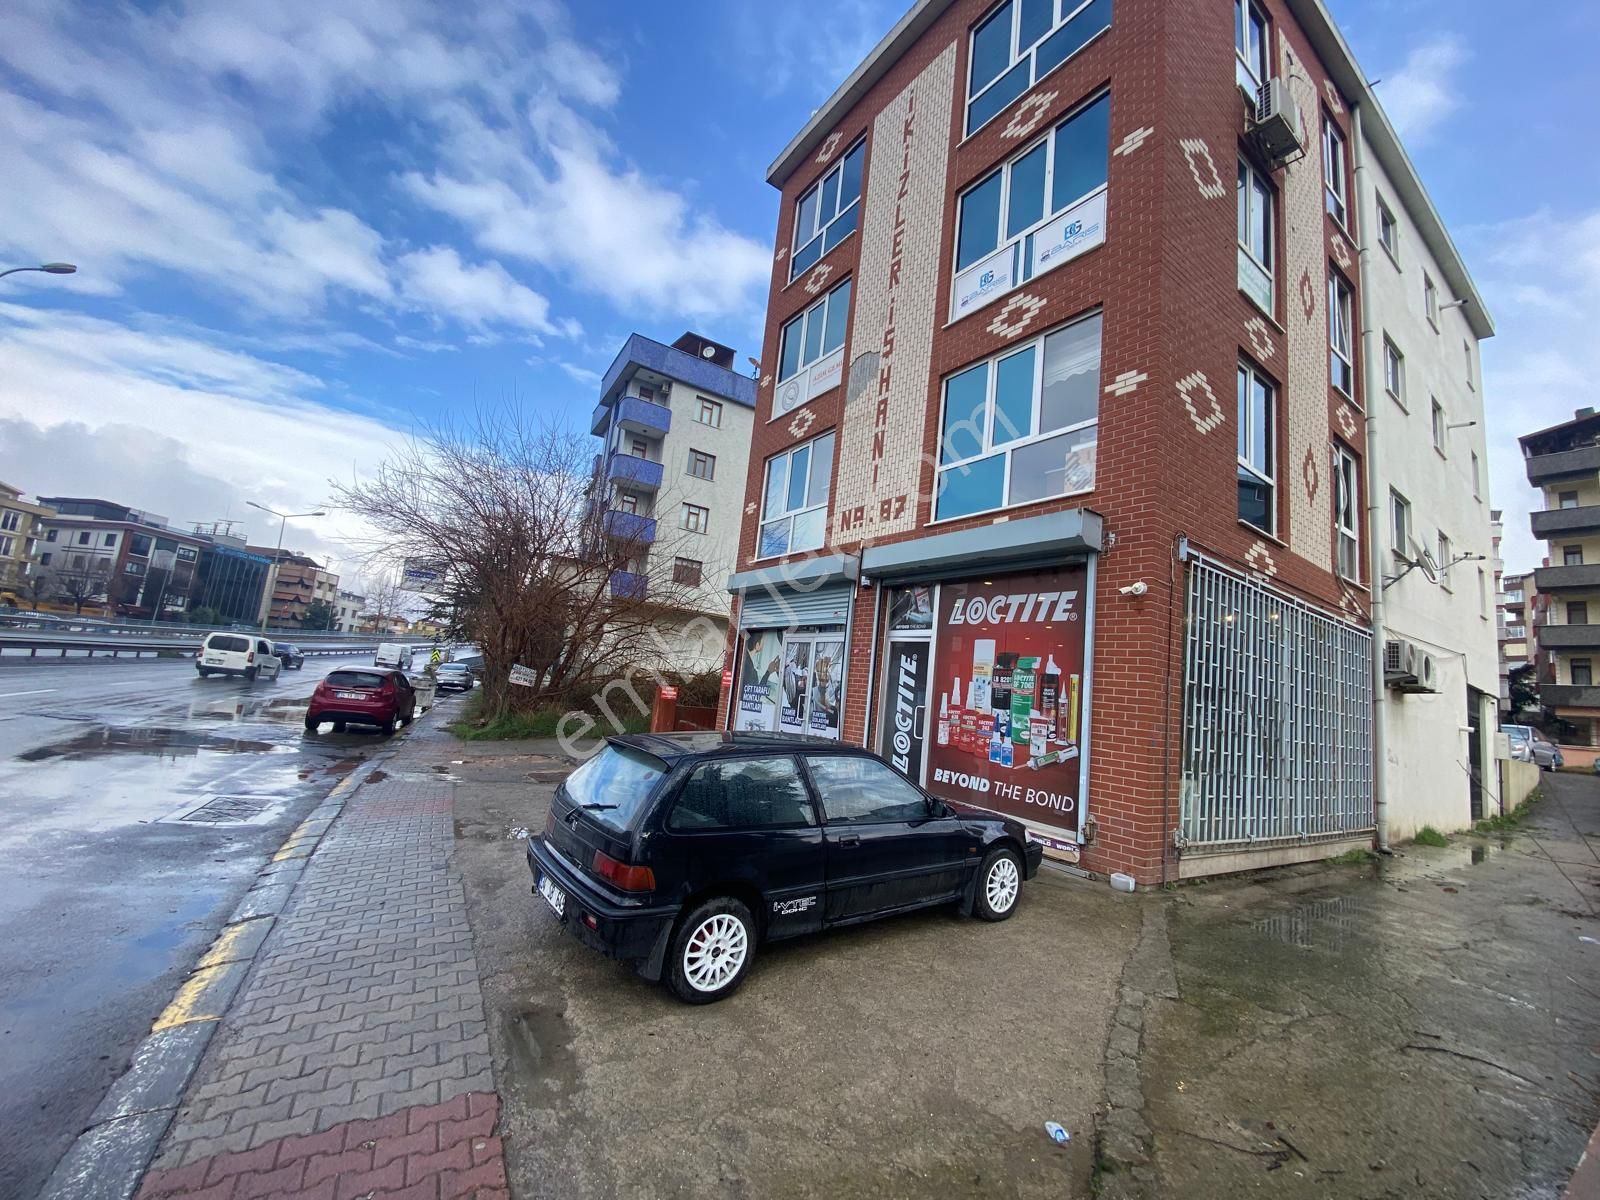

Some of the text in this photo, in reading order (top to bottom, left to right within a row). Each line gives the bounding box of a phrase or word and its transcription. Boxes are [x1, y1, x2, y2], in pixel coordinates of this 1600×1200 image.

[880, 494, 908, 523] 87
[934, 768, 1074, 812] BEYOND THE BOND
